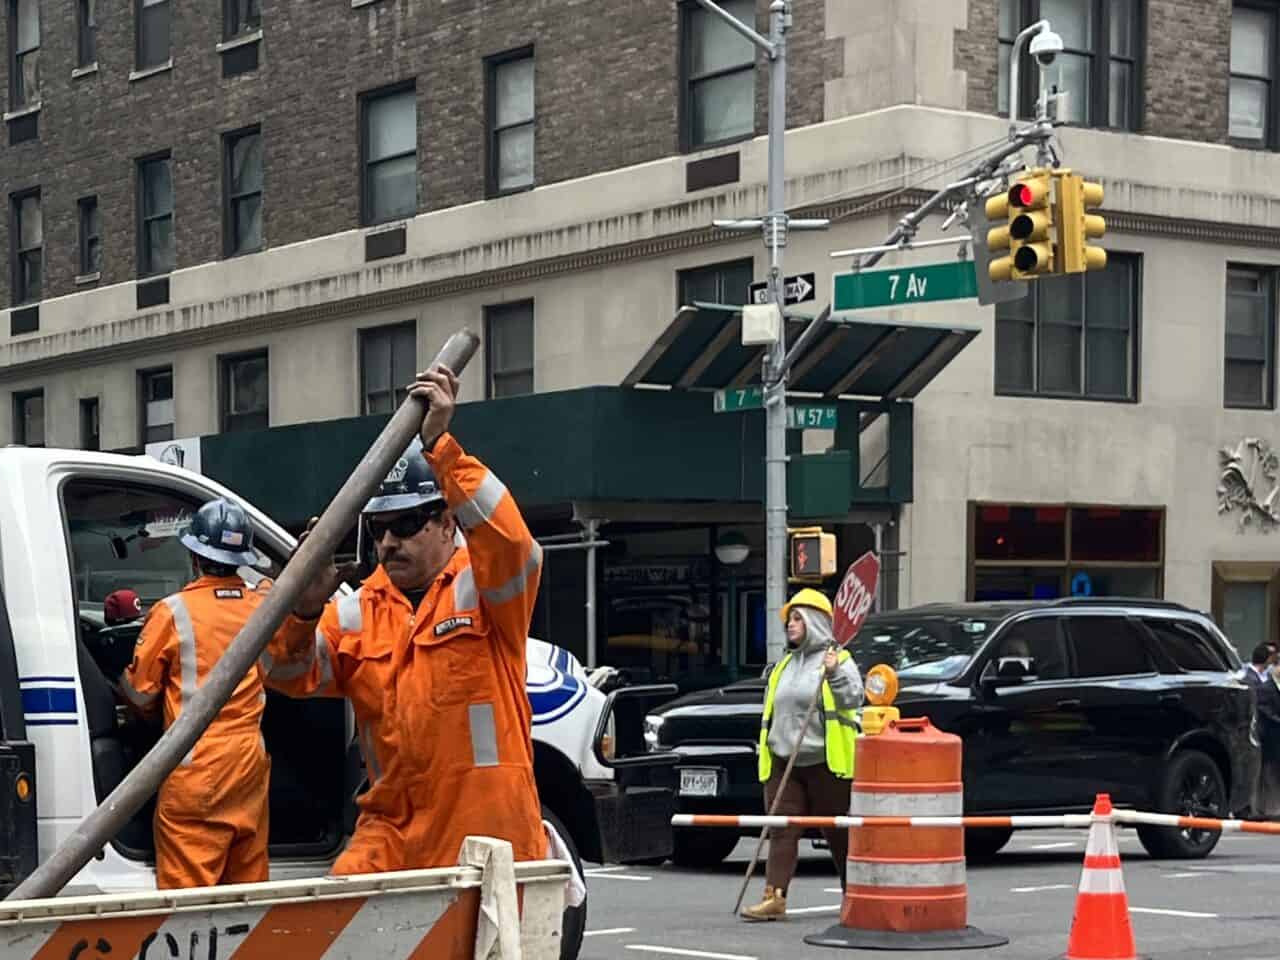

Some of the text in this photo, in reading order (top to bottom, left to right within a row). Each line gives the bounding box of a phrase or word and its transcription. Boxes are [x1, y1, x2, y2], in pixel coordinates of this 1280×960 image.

[889, 273, 927, 300] 7 Av
[736, 390, 746, 406] 7
[796, 408, 806, 425] W
[809, 408, 822, 425] 57
[837, 571, 872, 625] STOP
